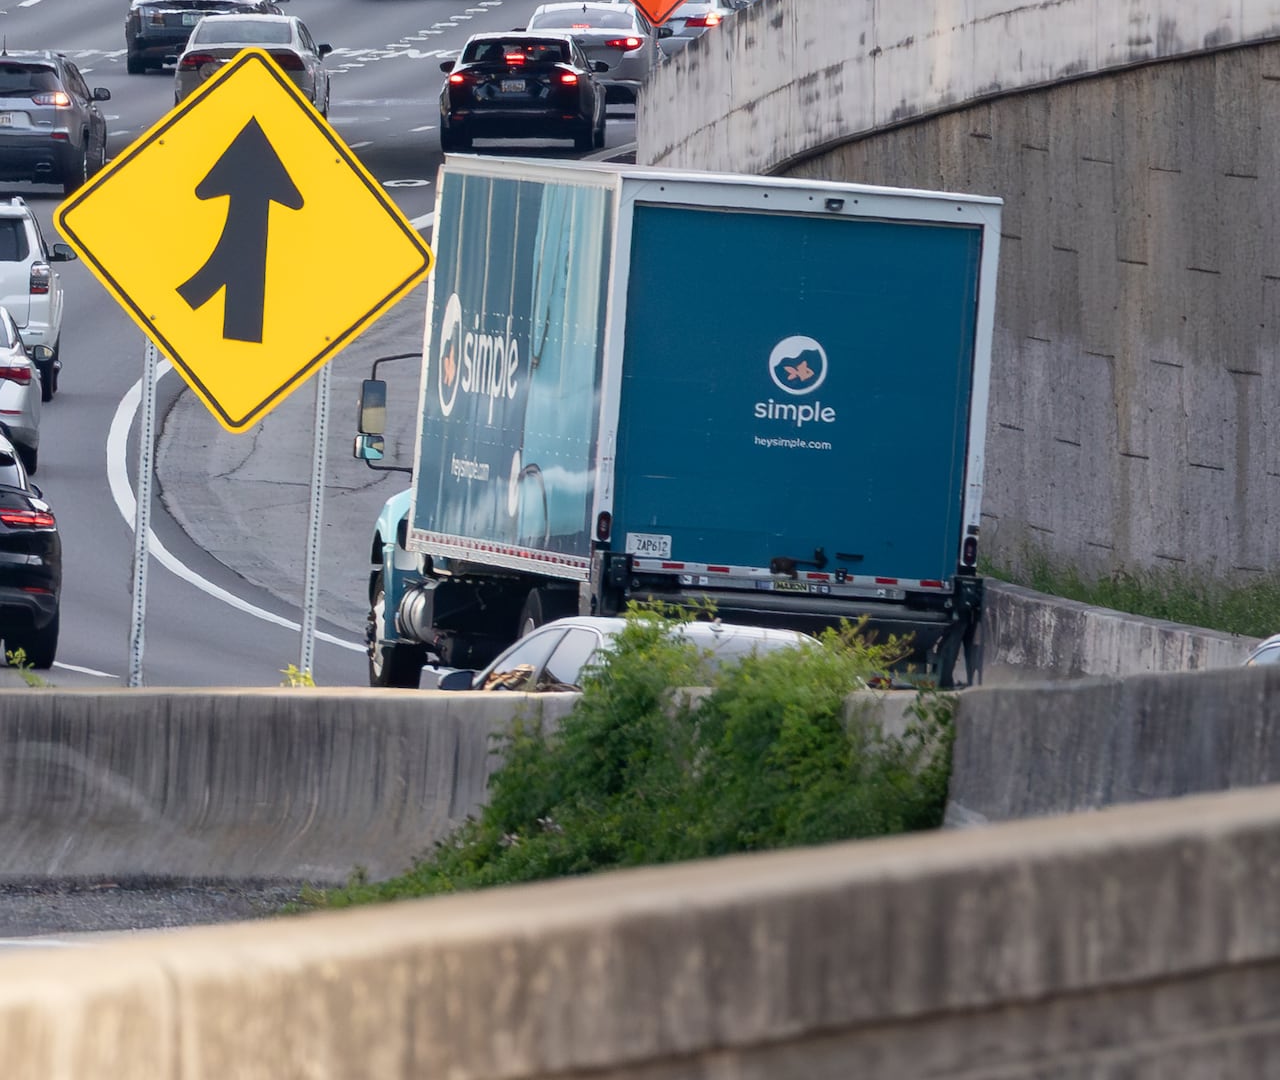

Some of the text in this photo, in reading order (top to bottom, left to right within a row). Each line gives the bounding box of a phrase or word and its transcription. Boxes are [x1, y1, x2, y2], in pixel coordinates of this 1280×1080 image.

[461, 315, 519, 425] simple
[754, 398, 837, 427] simple
[754, 436, 832, 450] heysimple.com
[637, 538, 668, 552] ZAP612
